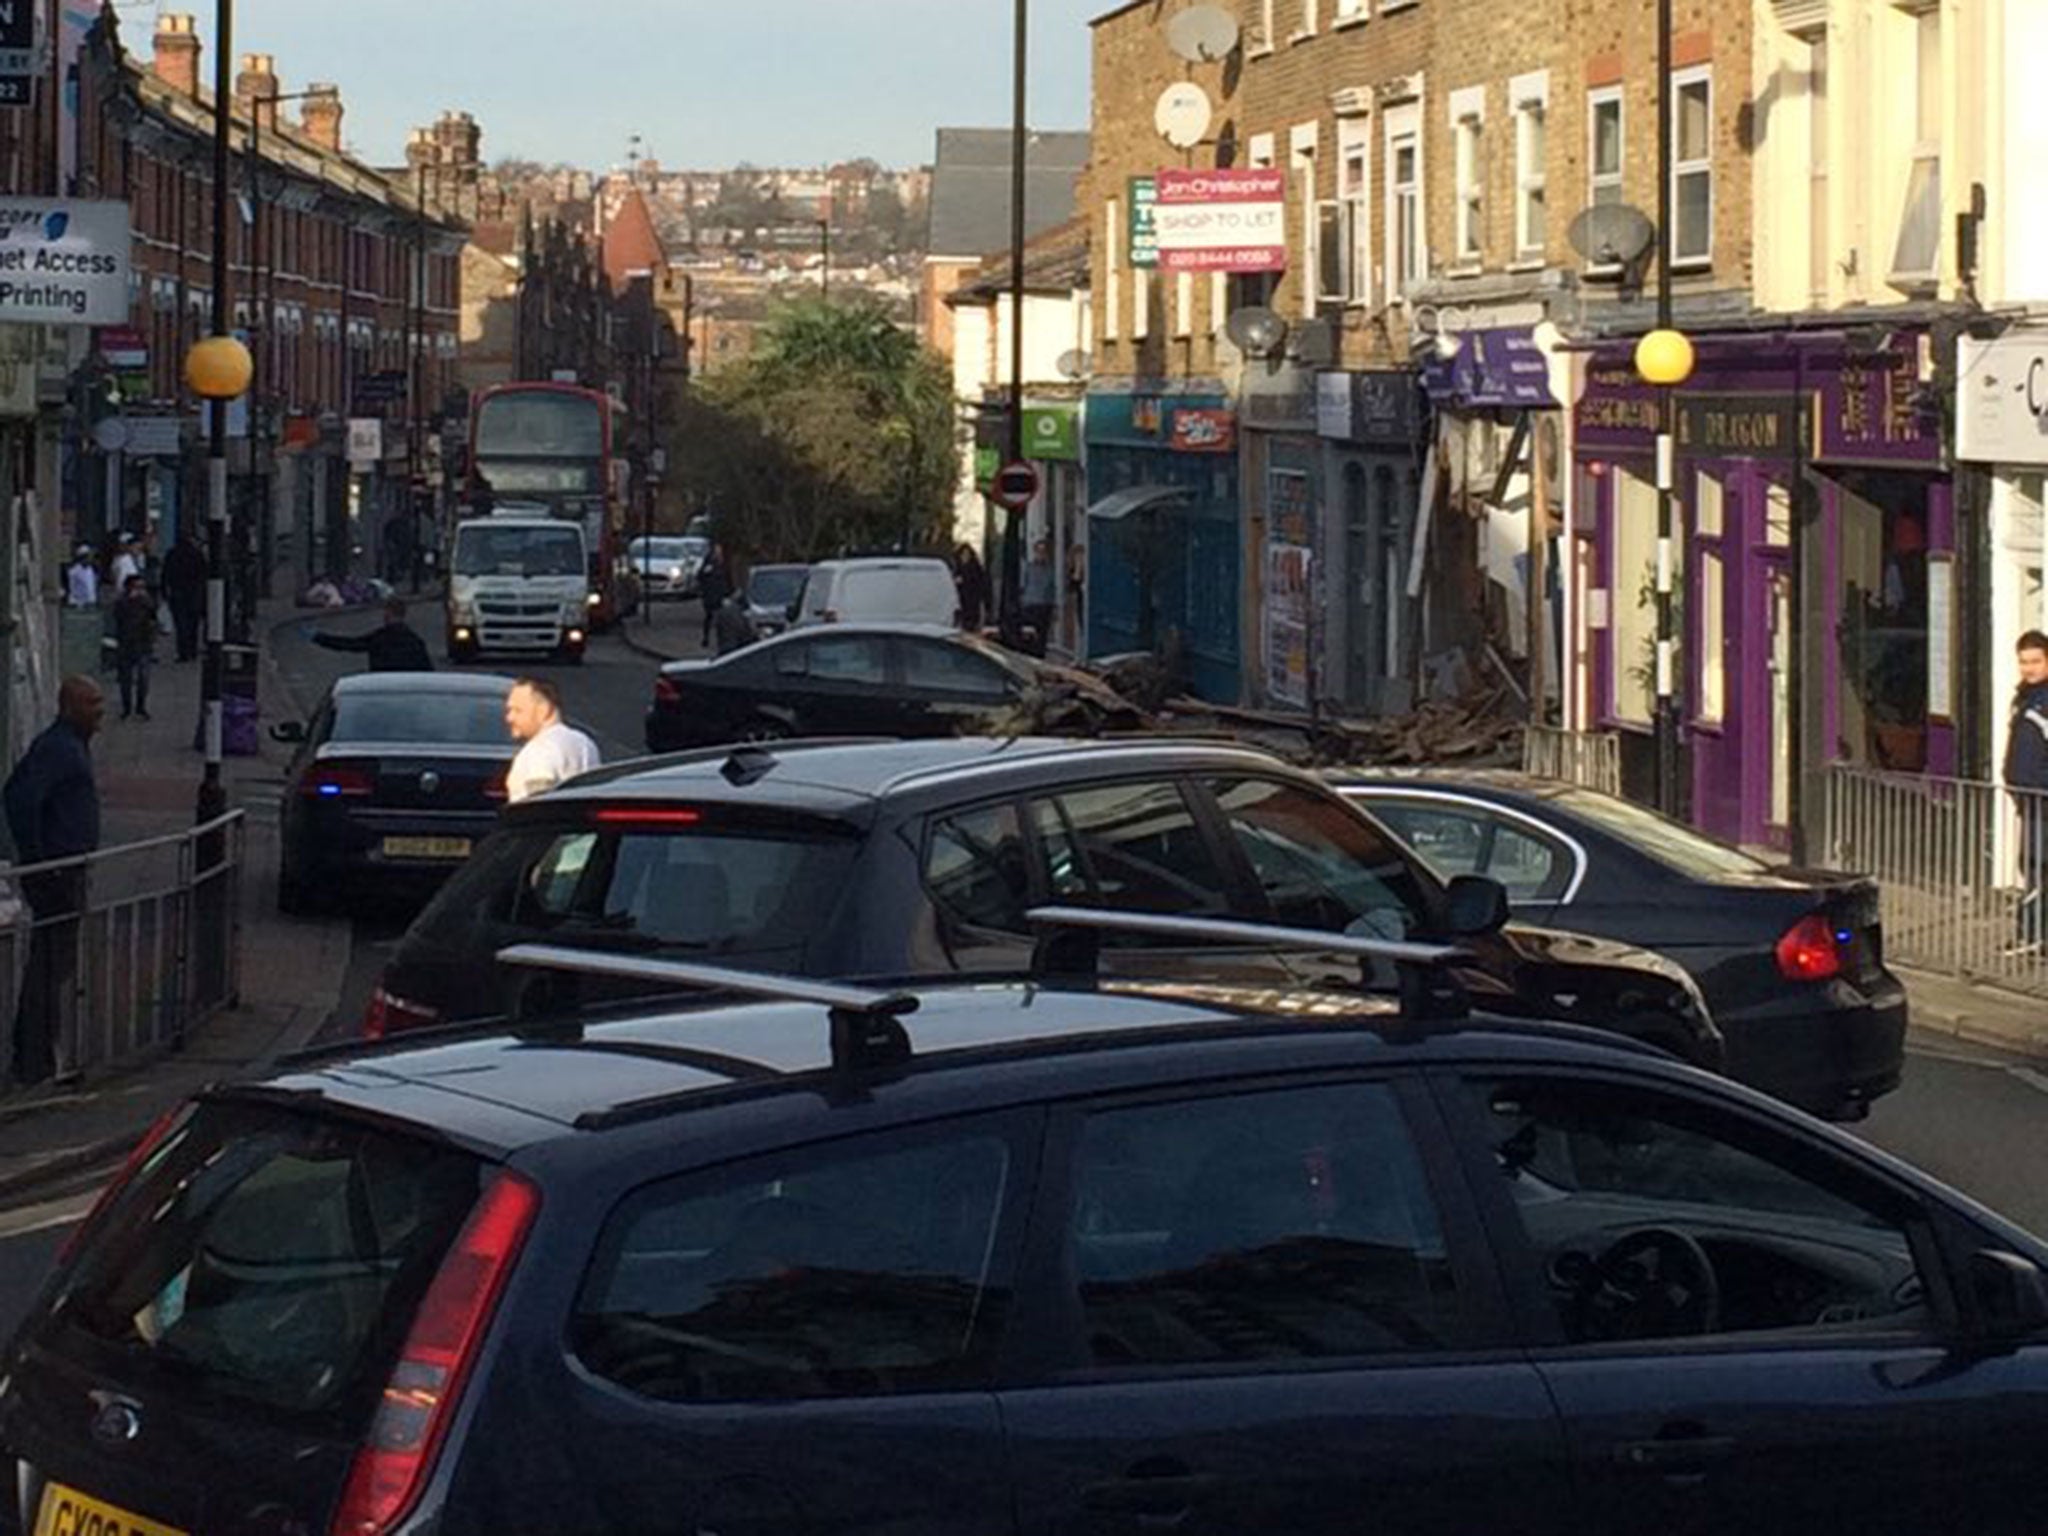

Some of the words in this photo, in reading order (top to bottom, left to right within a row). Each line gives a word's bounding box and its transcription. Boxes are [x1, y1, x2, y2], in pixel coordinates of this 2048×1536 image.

[1162, 212, 1213, 230] SHOP
[1216, 212, 1241, 229] TO
[1245, 210, 1276, 227] LET
[33, 247, 116, 274] Access
[0, 281, 87, 314] Printing
[1704, 410, 1778, 446] DRAGON
